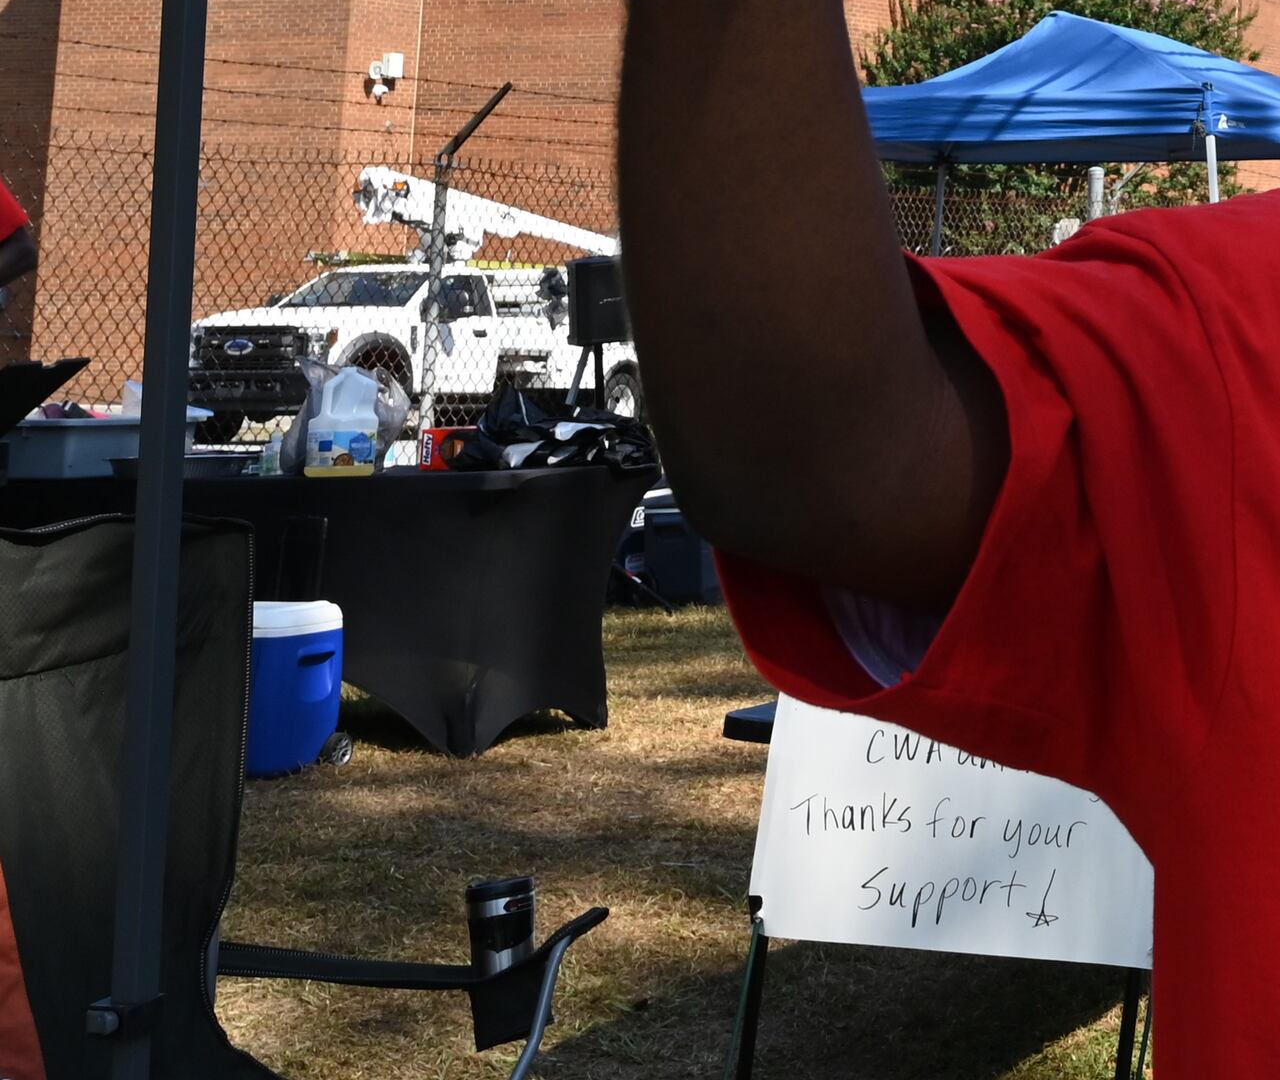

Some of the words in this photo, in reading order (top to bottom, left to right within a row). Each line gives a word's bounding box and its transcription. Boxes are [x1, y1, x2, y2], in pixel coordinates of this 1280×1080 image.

[422, 434, 432, 465] Hefty
[866, 729, 943, 764] CWA
[790, 792, 912, 836] Thanks
[925, 797, 987, 840] for
[1002, 819, 1088, 859] your
